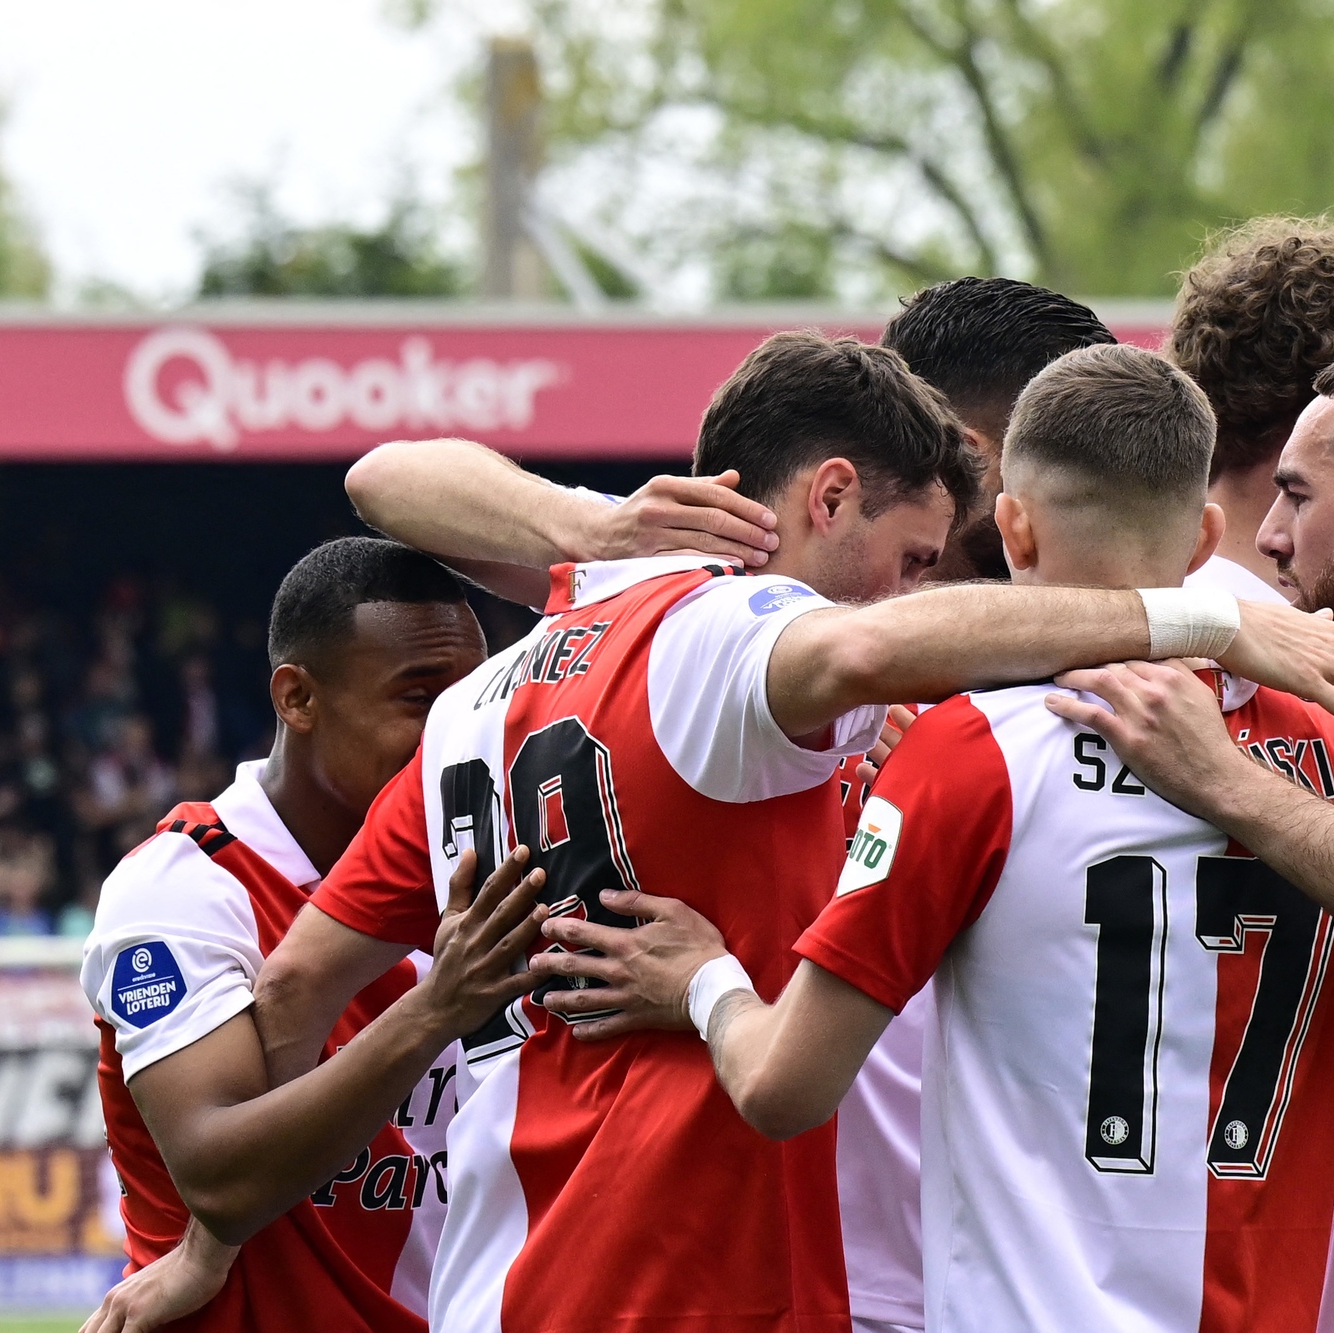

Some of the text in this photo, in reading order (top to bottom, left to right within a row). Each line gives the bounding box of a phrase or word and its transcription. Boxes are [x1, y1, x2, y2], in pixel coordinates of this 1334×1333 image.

[123, 323, 569, 451] Quooker
[848, 826, 888, 870] OTO
[118, 980, 177, 1004] VRIENDEN
[126, 993, 170, 1016] LOTERIJ
